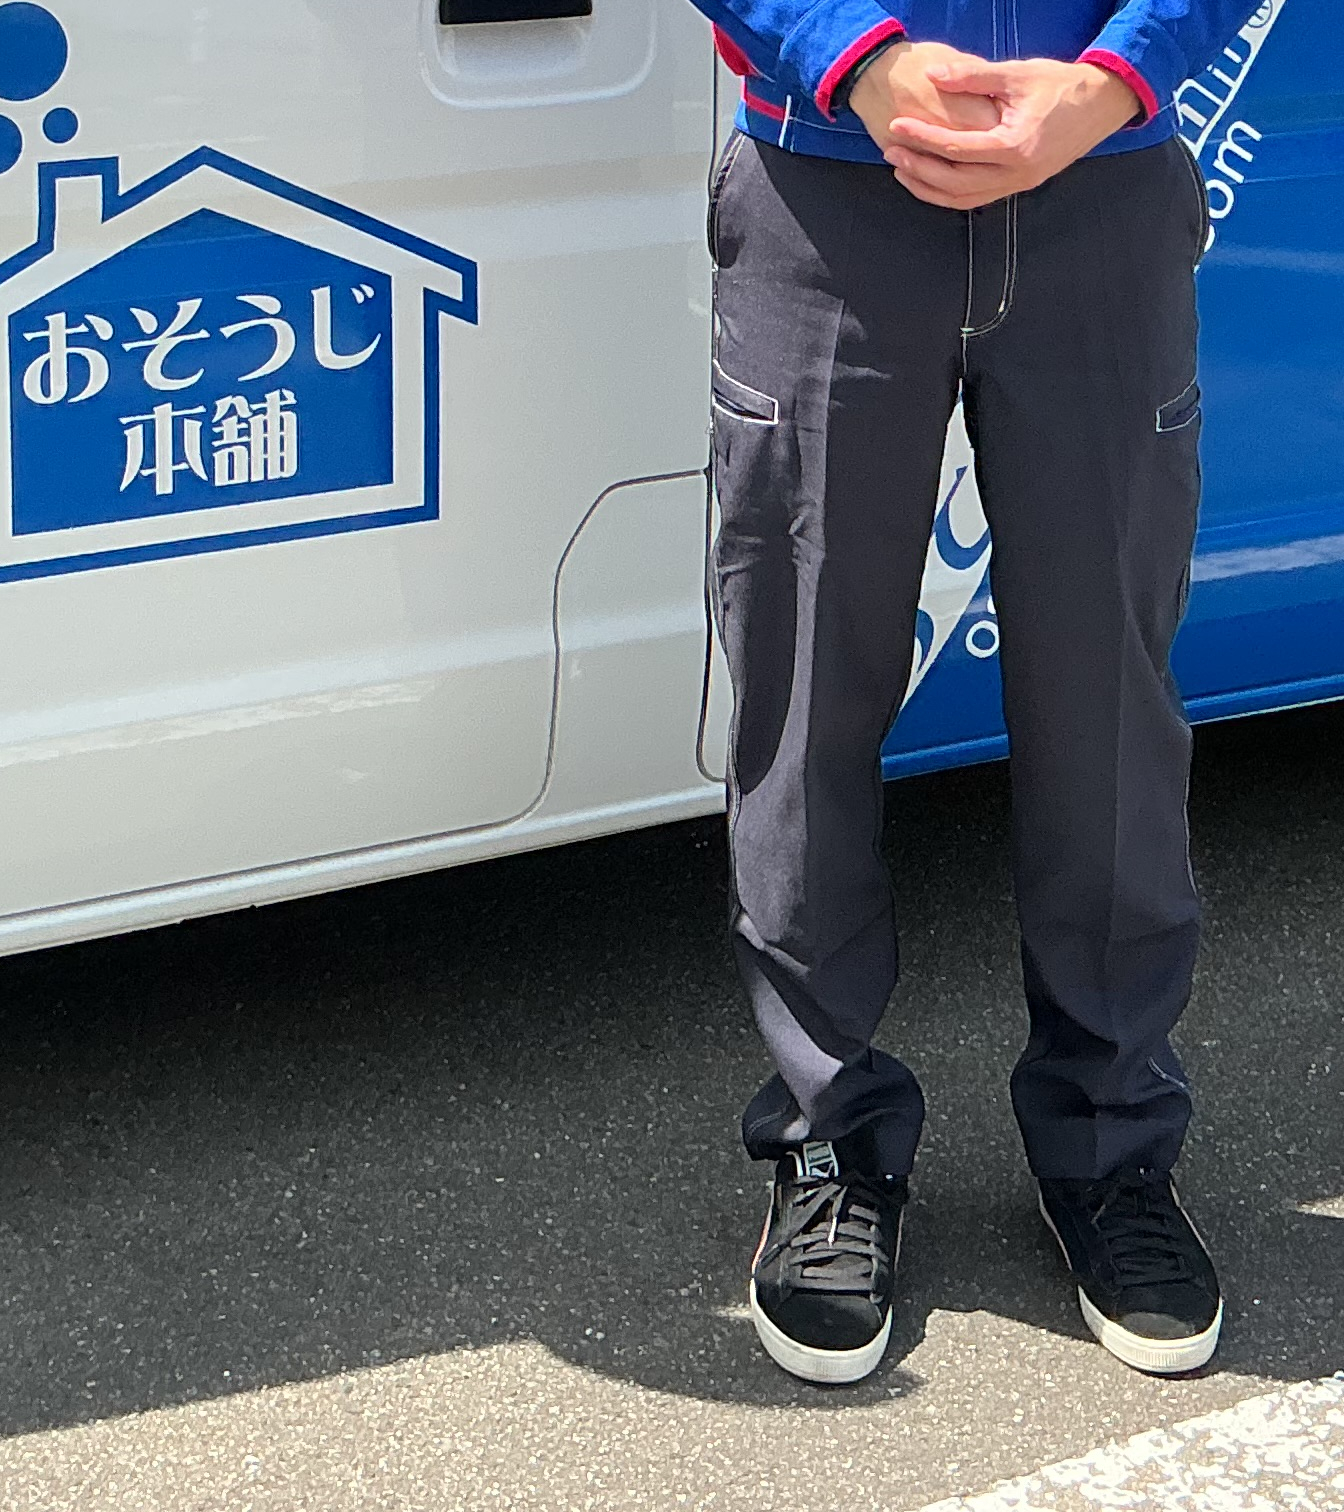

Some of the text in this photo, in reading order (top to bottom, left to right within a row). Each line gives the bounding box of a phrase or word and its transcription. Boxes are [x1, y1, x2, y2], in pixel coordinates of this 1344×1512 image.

[21, 283, 382, 405] おそうじ
[118, 388, 299, 497] 本舗
